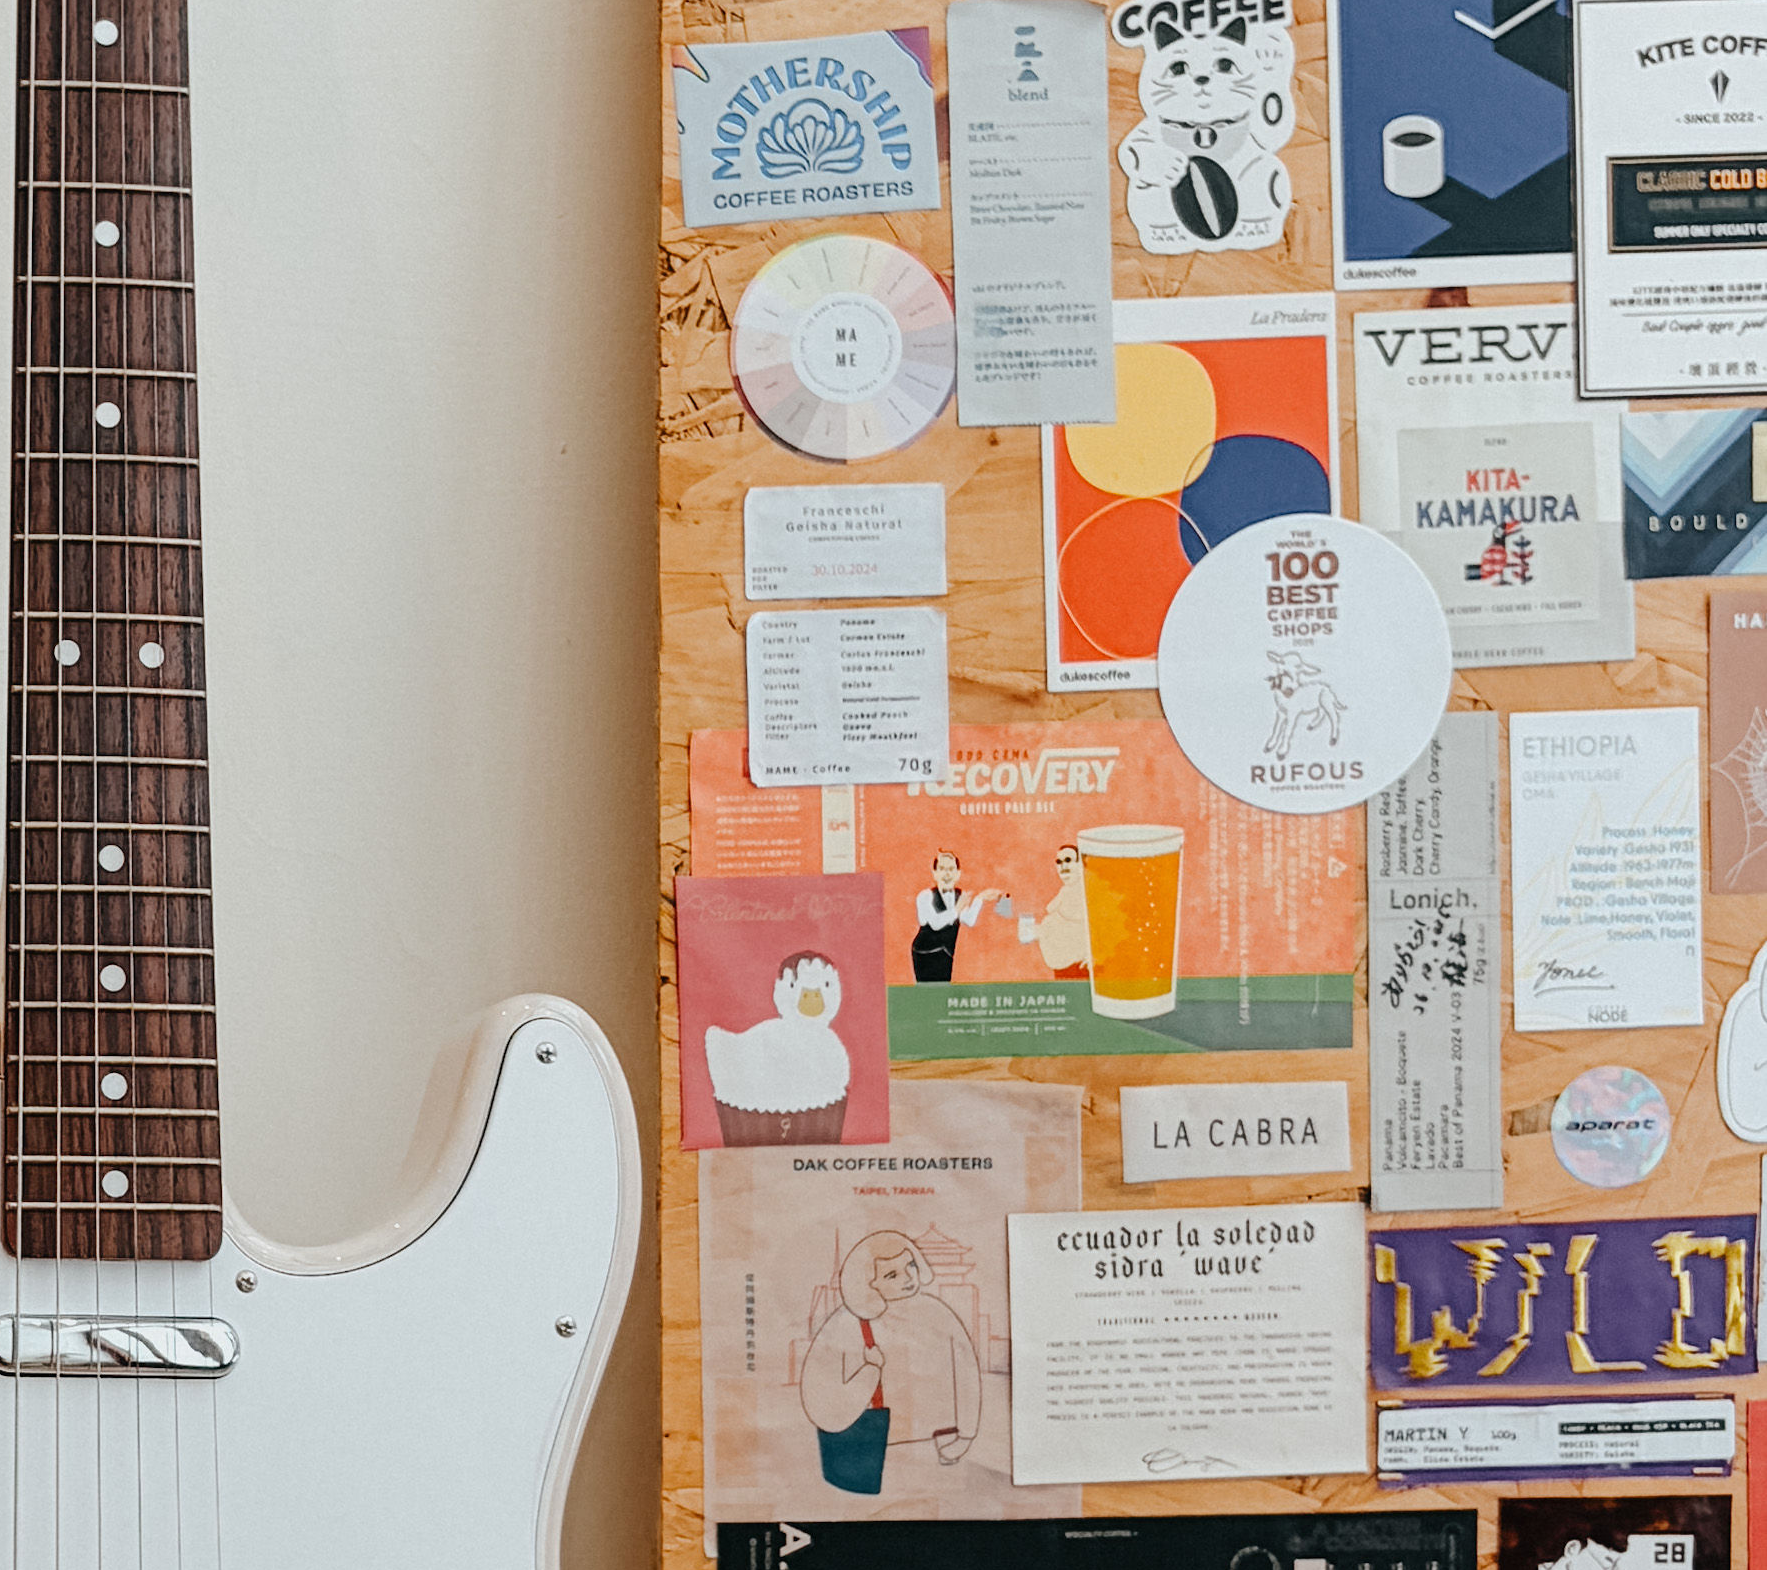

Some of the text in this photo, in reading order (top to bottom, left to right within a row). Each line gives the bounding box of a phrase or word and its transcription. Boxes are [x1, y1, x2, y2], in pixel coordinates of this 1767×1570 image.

[1636, 39, 1695, 68] KITE
[1008, 88, 1049, 102] blend
[711, 57, 914, 182] MOTHERSHIP
[1683, 112, 1755, 124] SINCE 2022
[1709, 169, 1754, 191] COLD
[713, 181, 914, 211] COFFEE ROASTERS
[1343, 265, 1417, 281] dukescoffee
[1250, 310, 1272, 325] La
[835, 329, 858, 343] MA
[1363, 322, 1576, 368] VERV
[835, 354, 858, 368] ME
[1407, 369, 1574, 386] COFFEE ROASTERS
[1466, 467, 1530, 493] KITA-
[802, 504, 885, 518] Franceschi
[1416, 494, 1581, 529] KAMAKURA
[786, 518, 903, 533] Geisha Natural
[811, 563, 879, 577] 30.10.2024
[1264, 550, 1340, 583] 100
[1266, 584, 1340, 607] BEST
[1267, 607, 1339, 622] COFFEE
[1734, 613, 1767, 629] HA
[1272, 622, 1334, 637] SHOPS
[1059, 670, 1131, 684] dukescoffee
[1522, 735, 1638, 759] ETHIOPIA
[765, 756, 933, 776] MAME Coffee 70g
[1250, 761, 1364, 784] RUFOUS
[1390, 888, 1477, 910] Lonich.
[948, 994, 1067, 1008] MADE IN JAPAN
[1588, 1009, 1628, 1023] NODE
[1153, 1117, 1319, 1149] LA CABRA
[793, 1156, 993, 1172] DAK COFFEE ROASTERS
[1057, 1217, 1316, 1251] ecuador la soledad
[1094, 1252, 1164, 1280] sidra
[1384, 1428, 1447, 1443] MARTIN
[1654, 1542, 1686, 1563] 28
